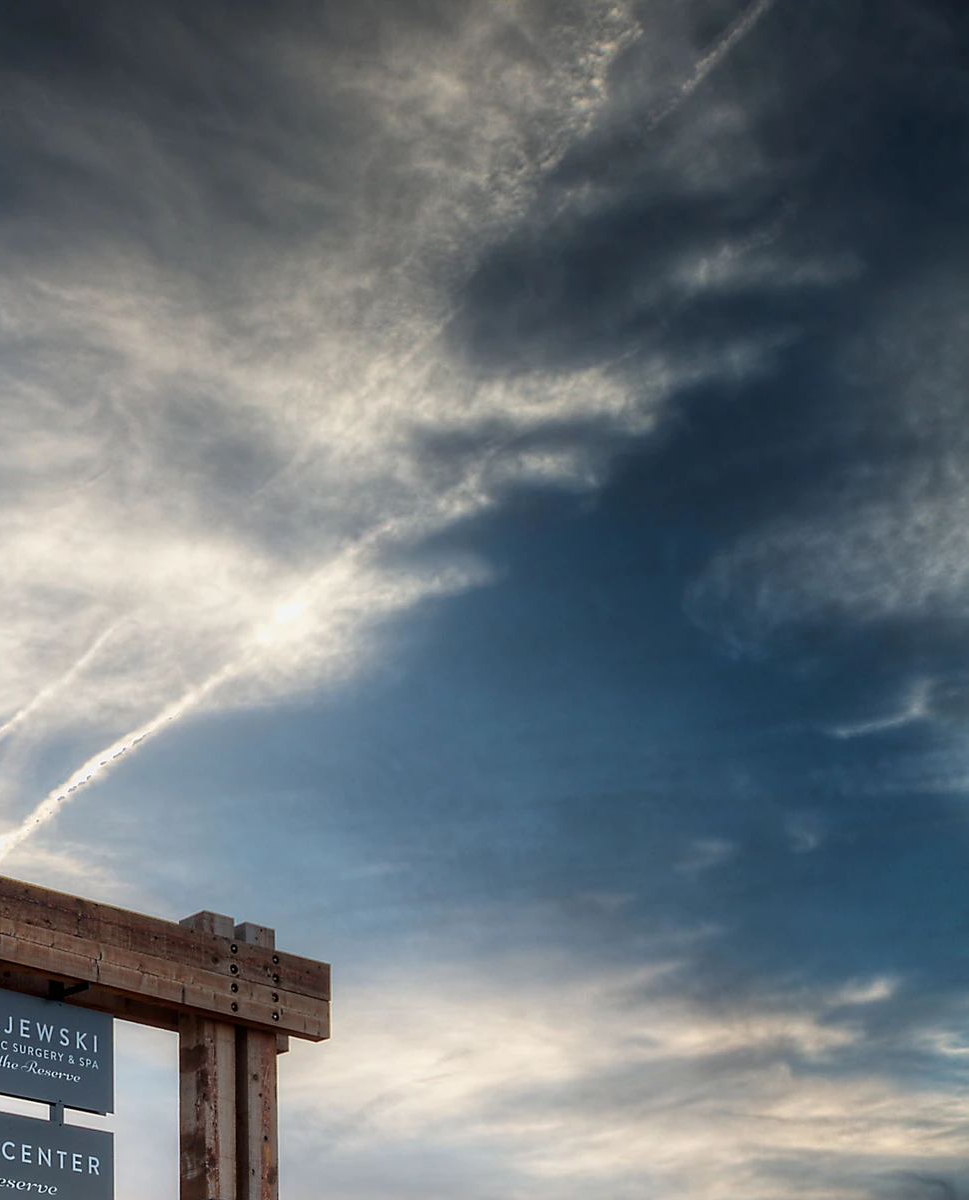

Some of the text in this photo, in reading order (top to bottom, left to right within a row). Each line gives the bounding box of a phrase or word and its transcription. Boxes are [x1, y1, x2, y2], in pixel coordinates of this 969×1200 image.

[12, 1043, 64, 1062] SURGERY
[68, 1055, 75, 1064] &
[79, 1058, 99, 1070] SPA
[21, 1060, 81, 1083] Reserve
[1, 1142, 100, 1176] CENTER
